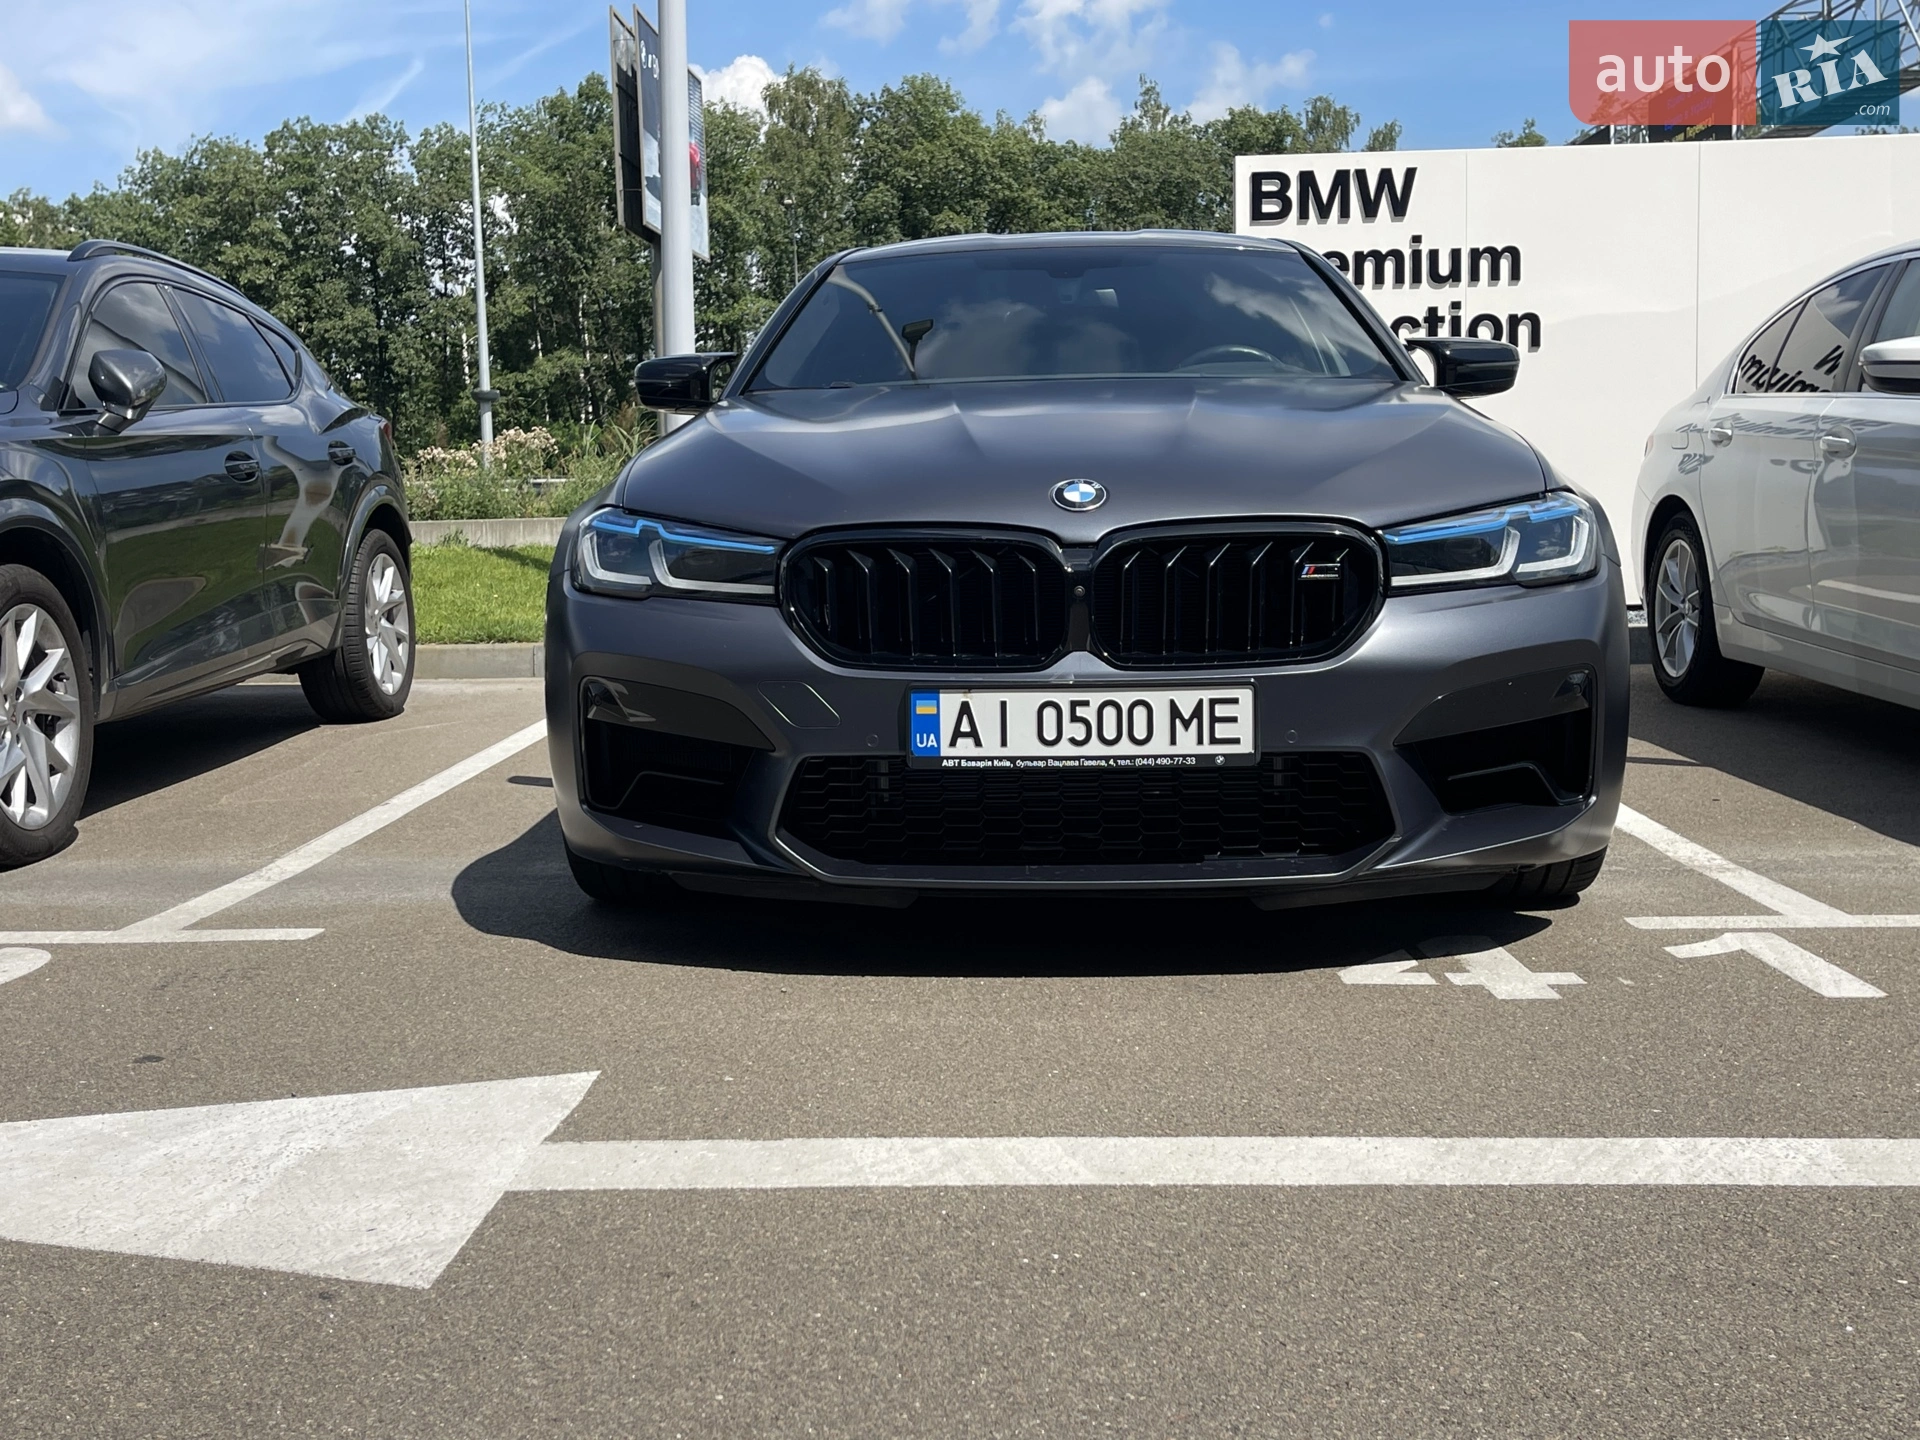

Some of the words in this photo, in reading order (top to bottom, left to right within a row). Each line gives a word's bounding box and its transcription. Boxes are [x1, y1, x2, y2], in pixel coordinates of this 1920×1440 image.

[1250, 167, 1418, 226] BMW
[1321, 234, 1522, 290] emium
[1390, 301, 1541, 353] ction
[916, 733, 938, 748] UA
[1036, 699, 1154, 747] 0500
[1169, 697, 1241, 746] ME
[942, 759, 960, 767] АВТ
[1135, 758, 1155, 767] (044)
[1155, 757, 1196, 766] 490-77-33
